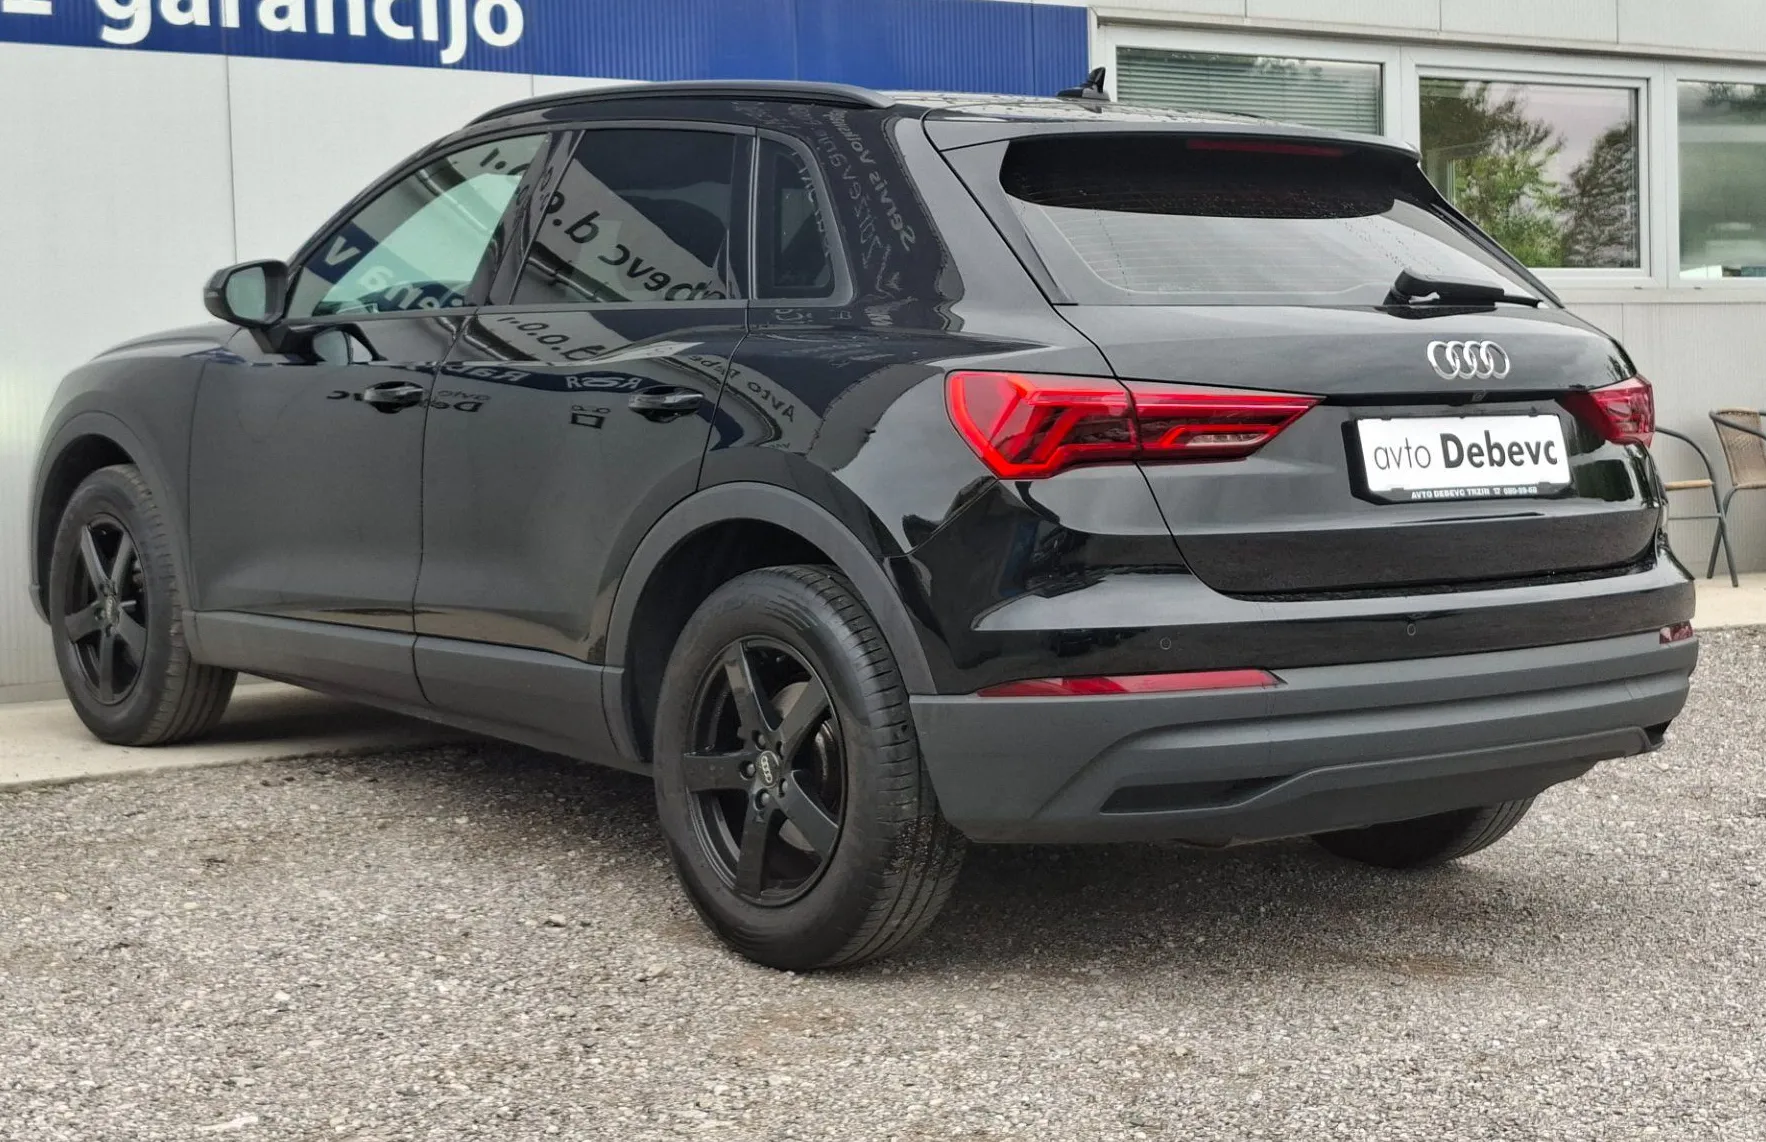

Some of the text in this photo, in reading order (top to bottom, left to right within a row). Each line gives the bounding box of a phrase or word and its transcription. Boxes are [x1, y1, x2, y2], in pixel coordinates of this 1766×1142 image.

[1374, 430, 1558, 471] avto Debevc
[1411, 490, 1433, 500] AVTO
